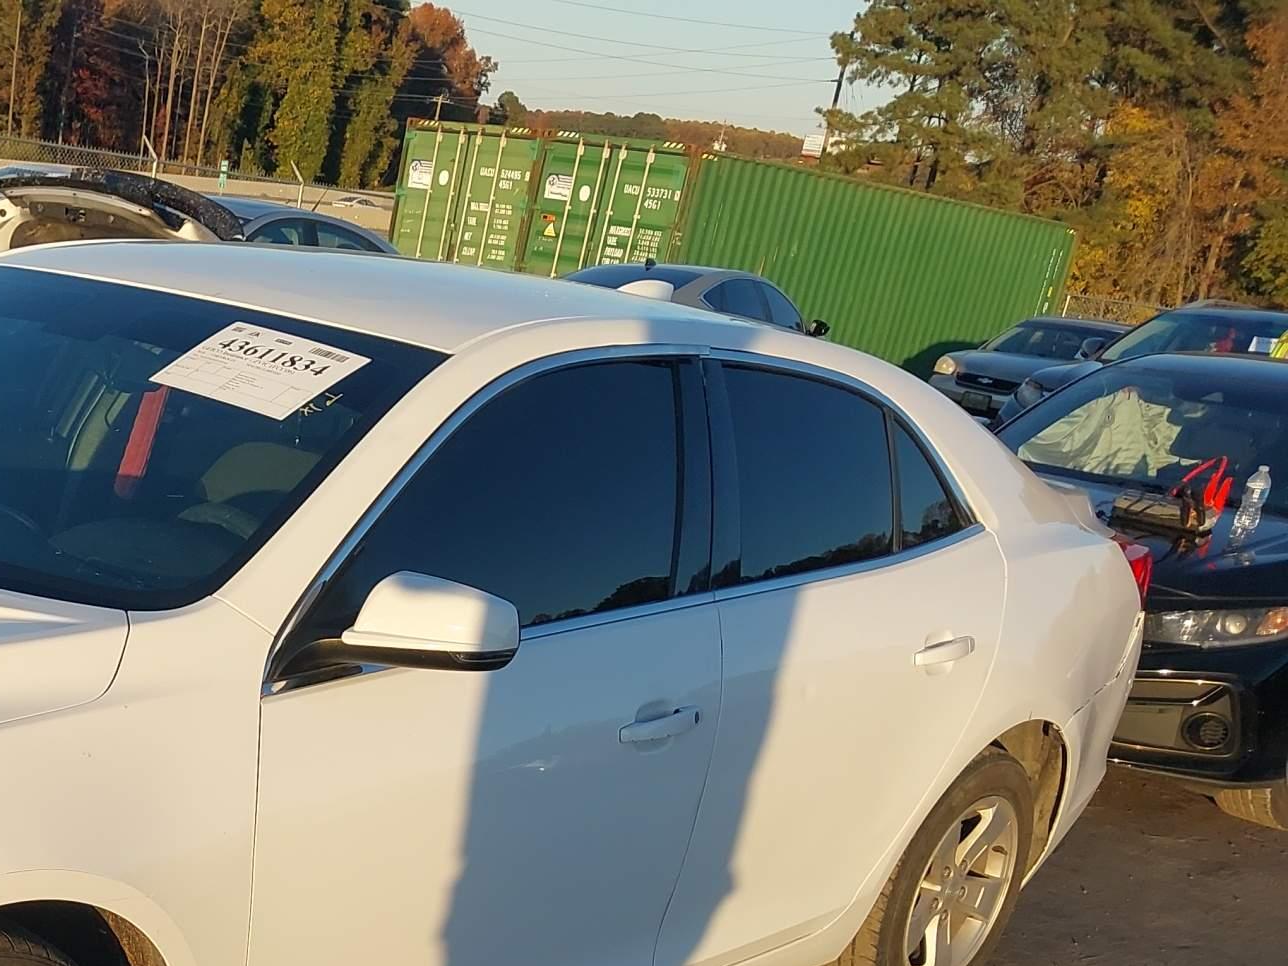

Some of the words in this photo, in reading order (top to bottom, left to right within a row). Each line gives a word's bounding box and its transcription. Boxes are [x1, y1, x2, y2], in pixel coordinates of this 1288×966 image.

[623, 183, 640, 196] UACU
[646, 187, 672, 199] 533731
[643, 198, 661, 210] 45G1
[218, 338, 331, 376] 43611834
